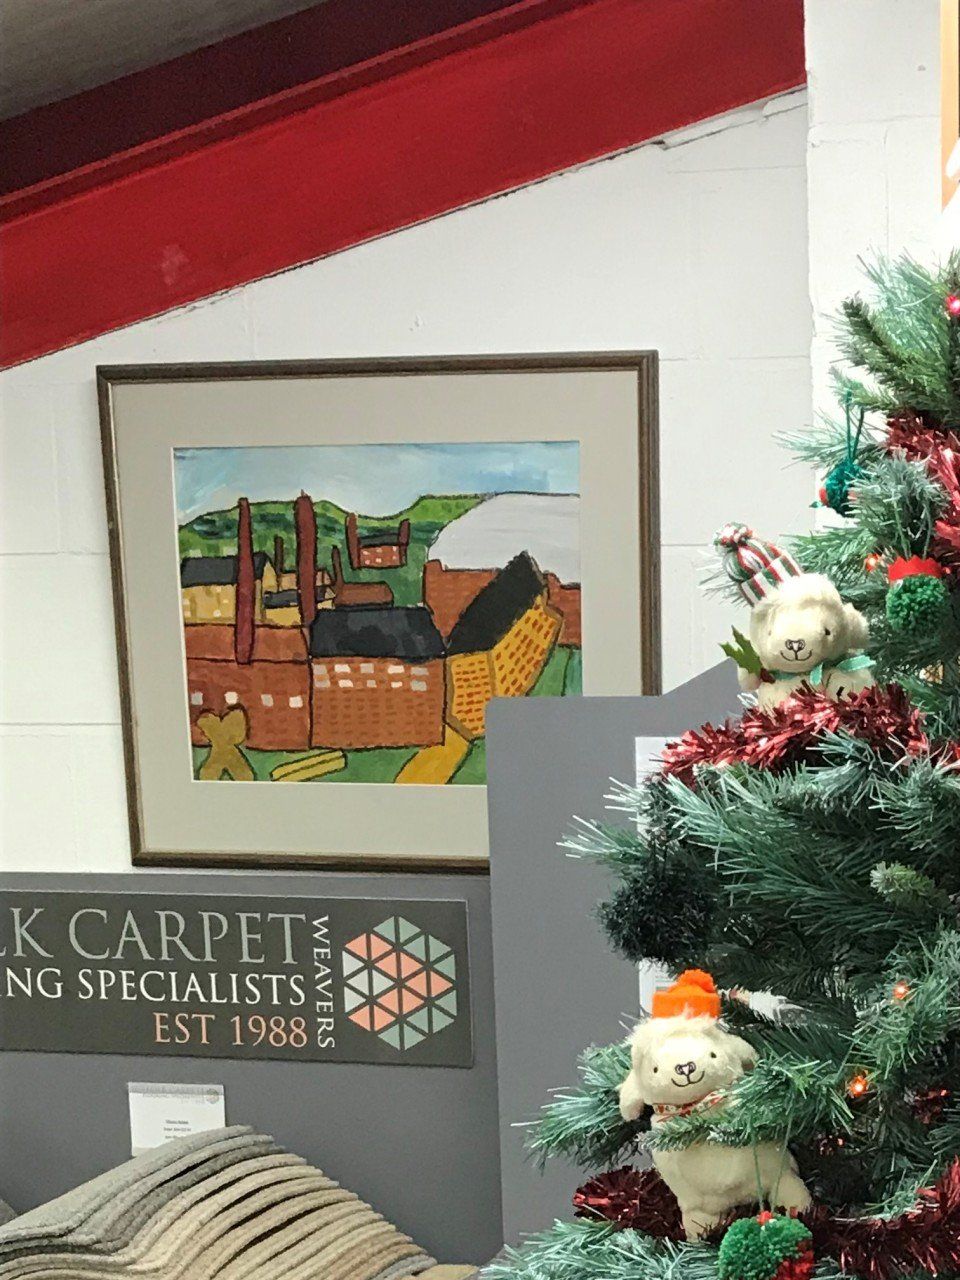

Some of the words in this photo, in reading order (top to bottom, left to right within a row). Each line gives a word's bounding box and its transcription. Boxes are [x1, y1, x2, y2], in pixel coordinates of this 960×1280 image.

[69, 907, 306, 965] CARPET
[78, 969, 306, 1006] SPECIALISTS
[312, 914, 336, 1050] WEAVERS
[153, 1011, 216, 1045] EST
[230, 1015, 308, 1048] 1988
